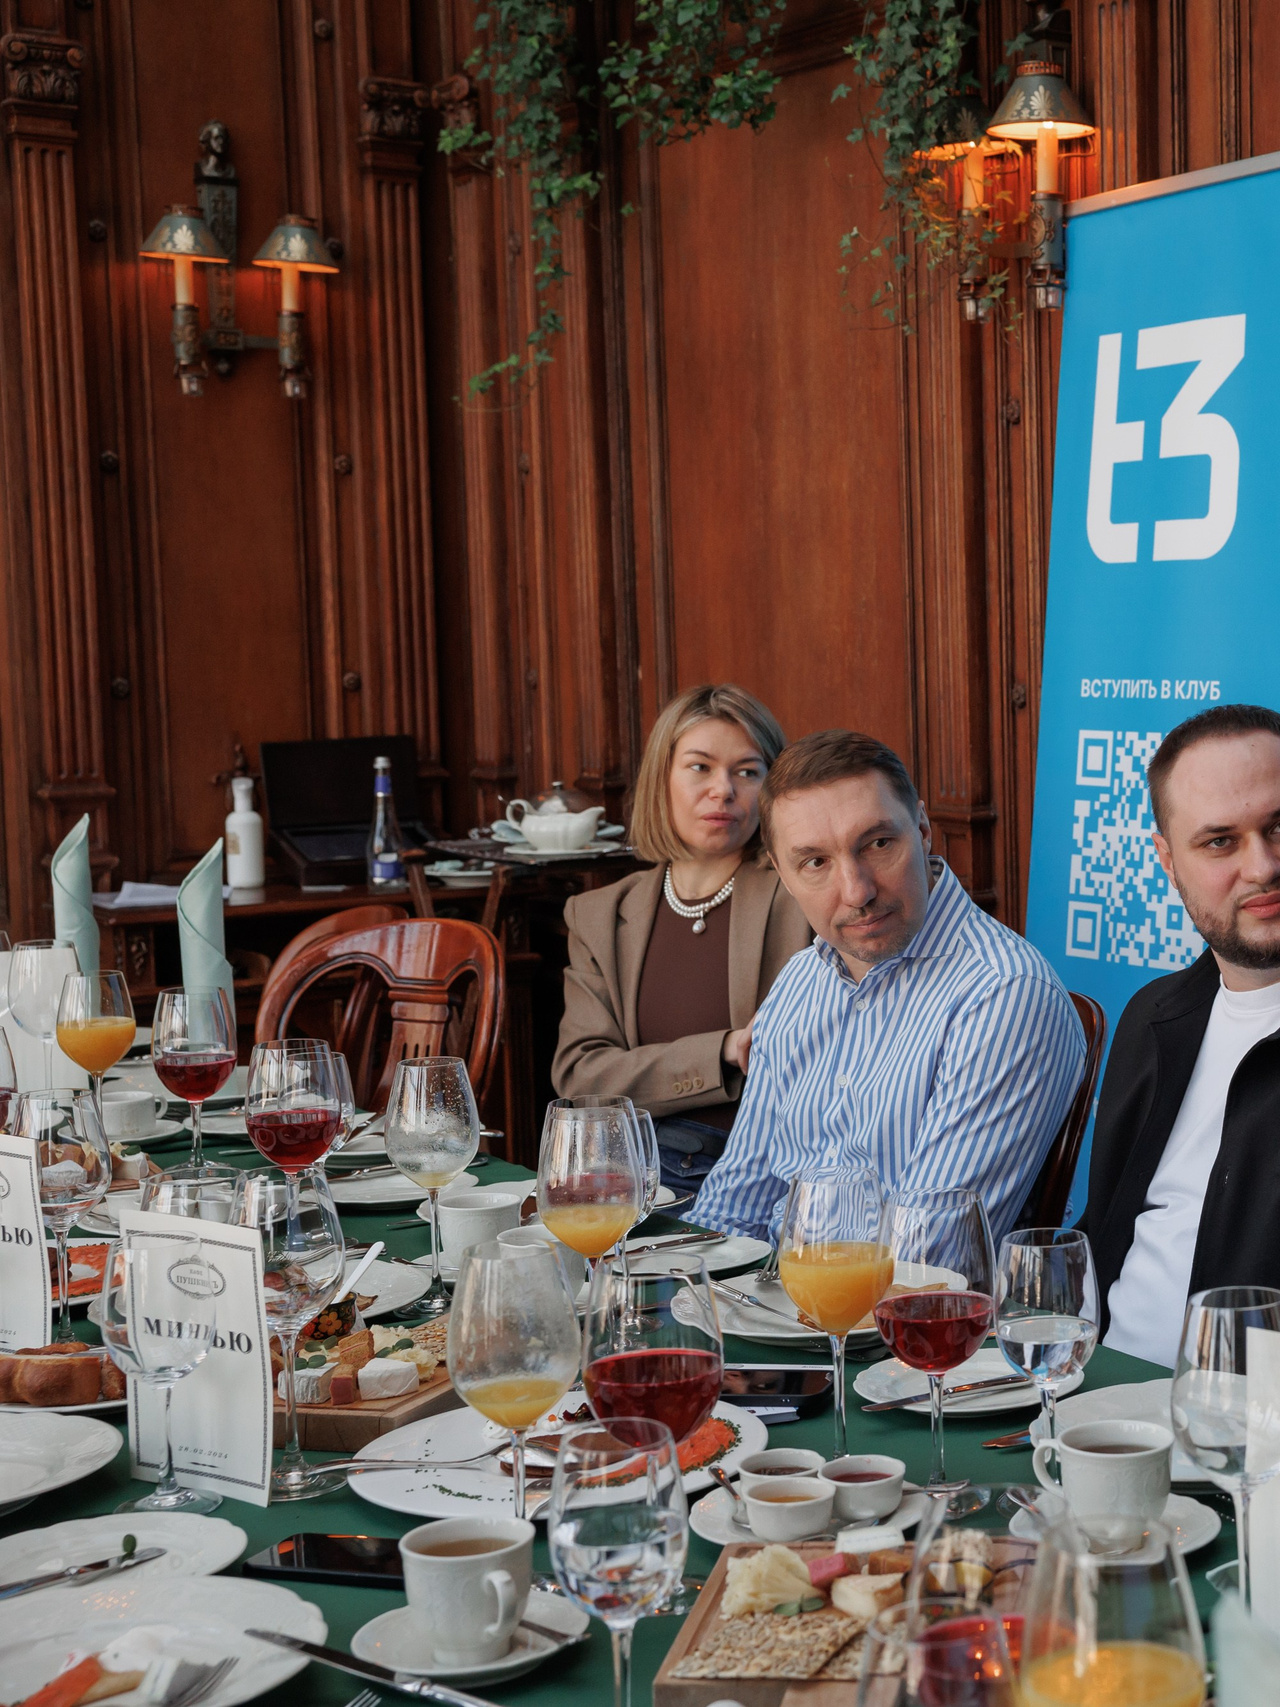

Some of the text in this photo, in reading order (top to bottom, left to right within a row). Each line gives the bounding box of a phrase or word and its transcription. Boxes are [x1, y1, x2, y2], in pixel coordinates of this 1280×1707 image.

[1080, 678, 1221, 701] ВСТУПИТЬ В КЛУБ
[0, 1225, 33, 1246] ЬЮ
